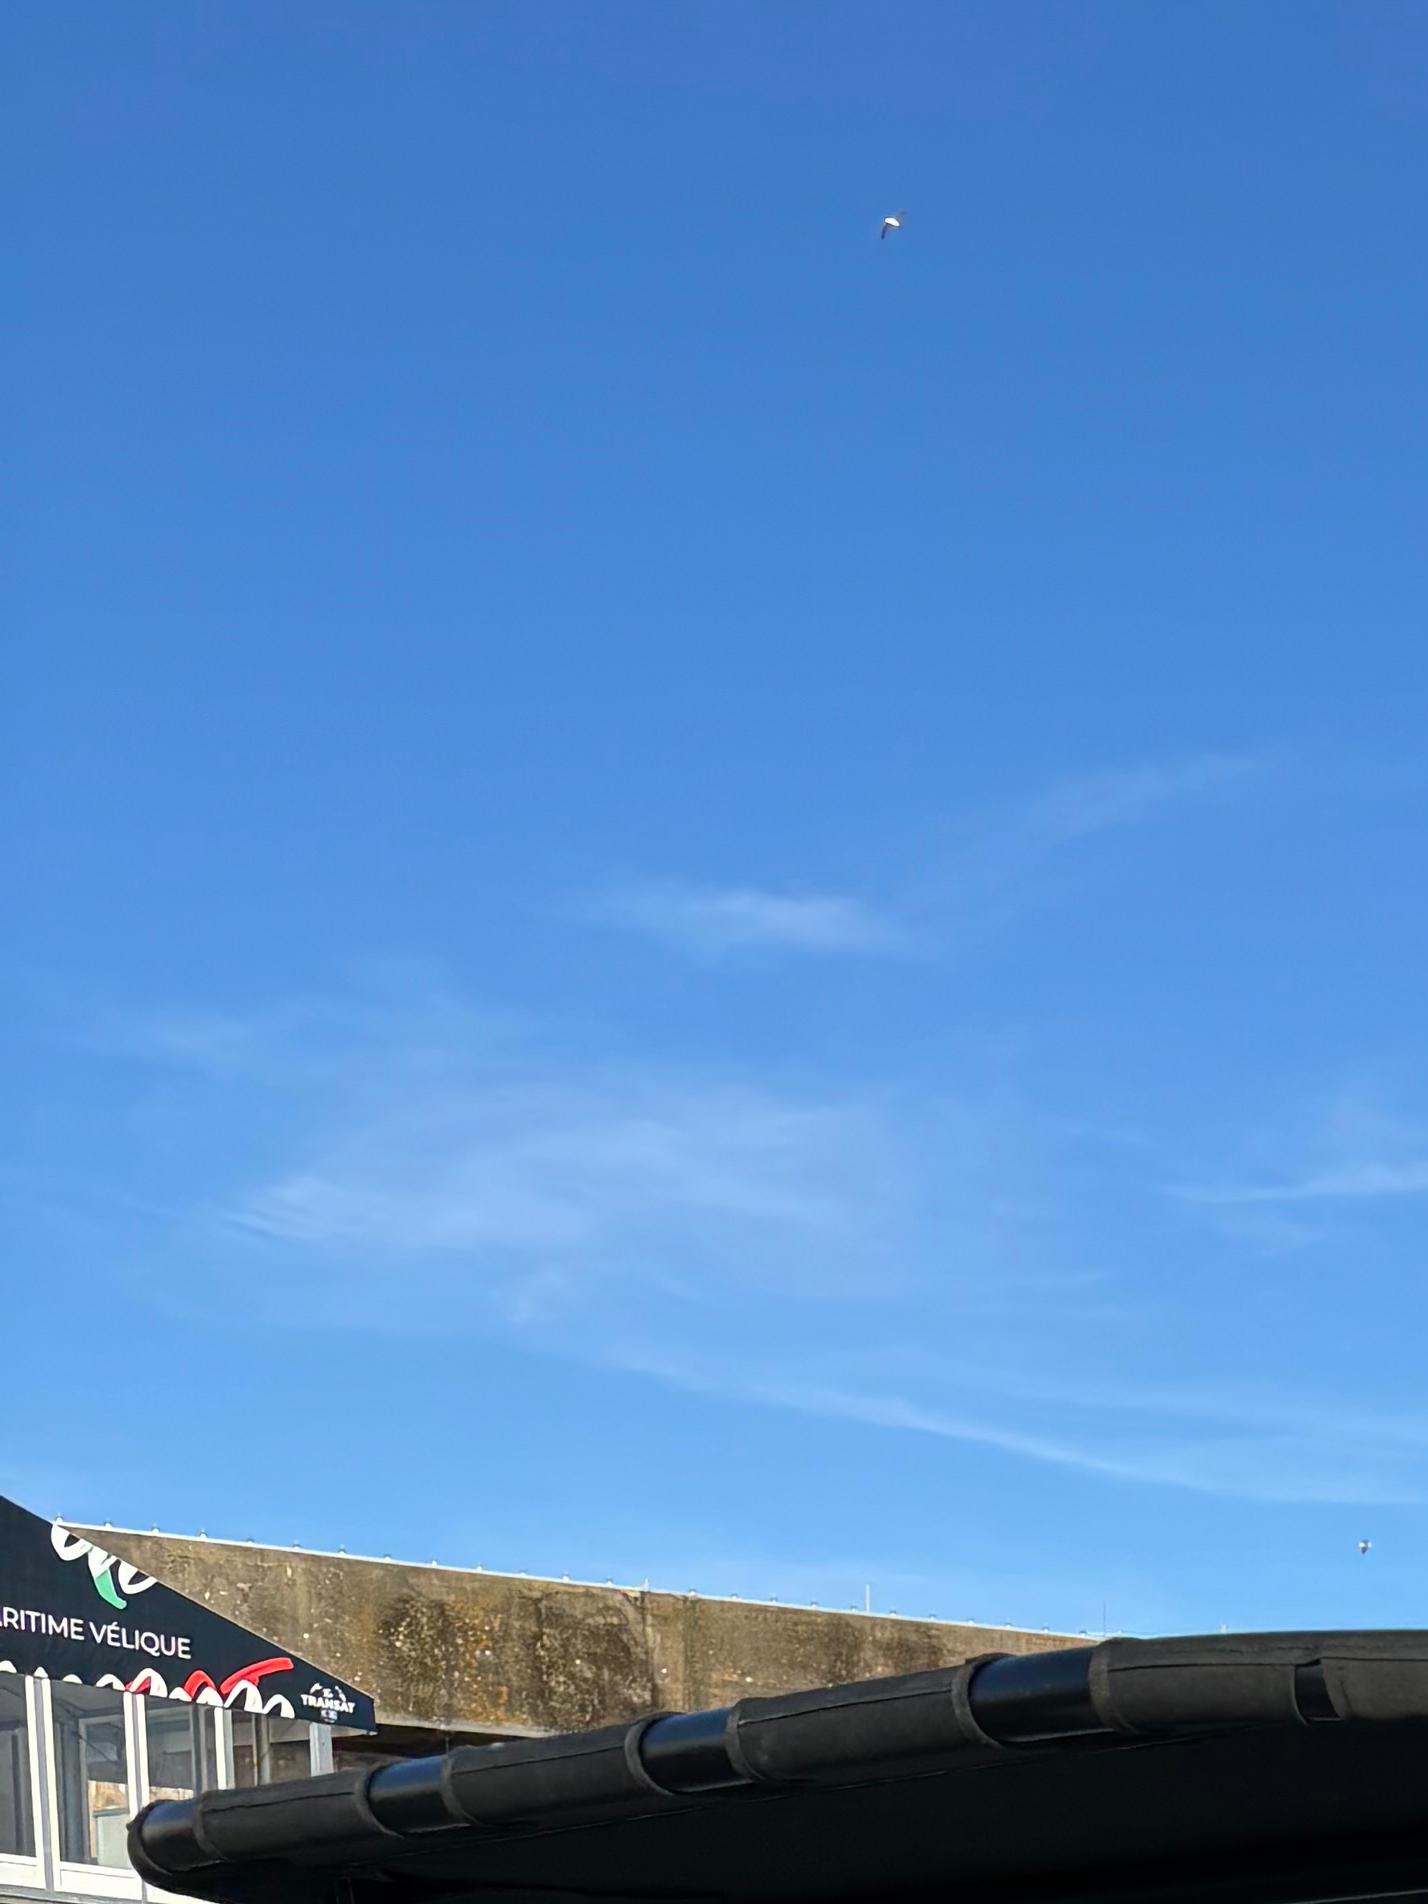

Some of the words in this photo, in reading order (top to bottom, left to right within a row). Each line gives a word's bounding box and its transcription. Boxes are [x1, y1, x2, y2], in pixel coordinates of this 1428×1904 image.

[0, 1606, 85, 1641] RITIME
[89, 1621, 192, 1660] VÉLIQUE
[301, 1694, 356, 1714] TRANSAT
